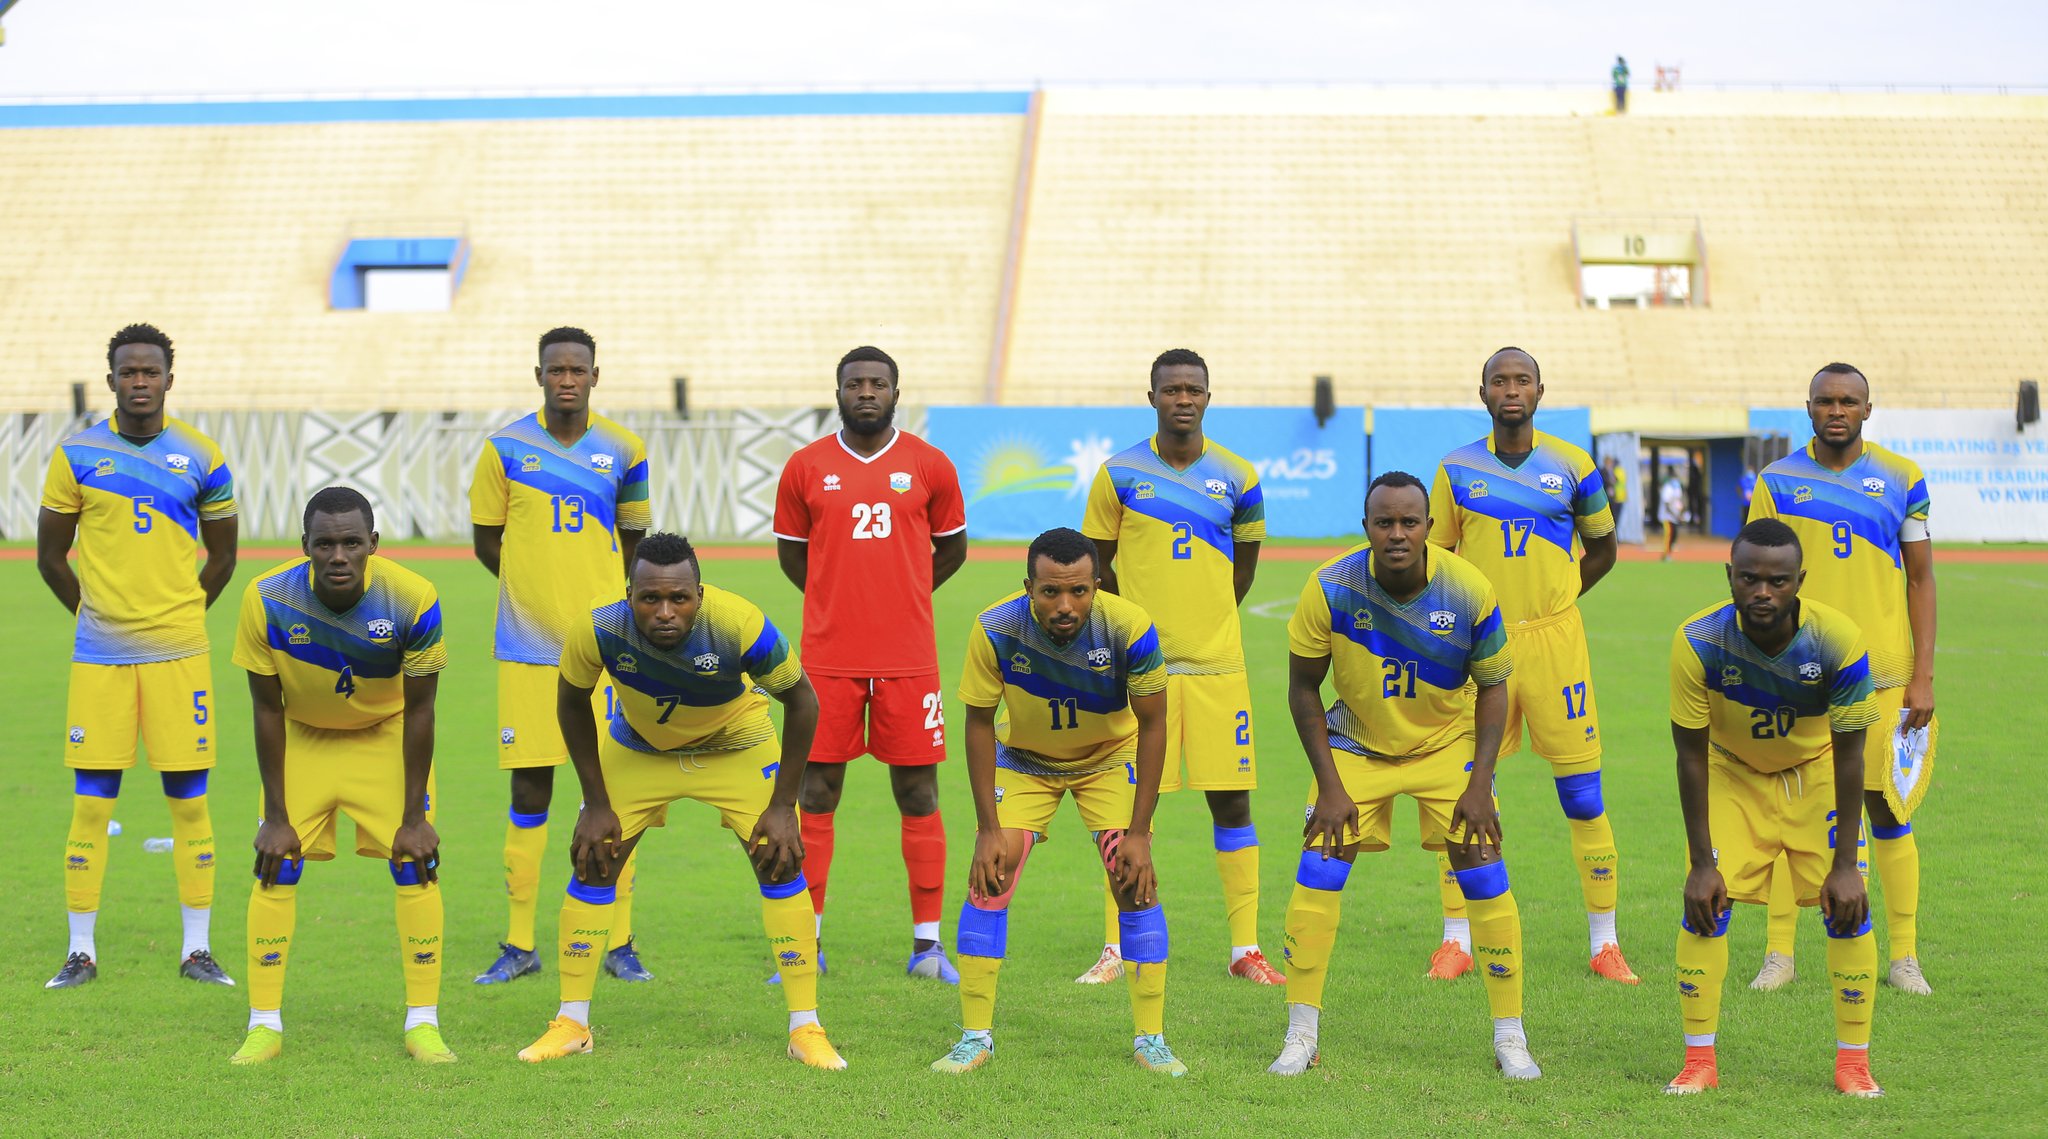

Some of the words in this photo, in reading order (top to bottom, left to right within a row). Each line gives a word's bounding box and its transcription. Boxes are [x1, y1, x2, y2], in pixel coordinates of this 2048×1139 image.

[1624, 235, 1646, 256] 10
[132, 496, 154, 534] 5
[550, 495, 585, 533] 13
[852, 502, 892, 540] 23
[1172, 521, 1192, 560] 2
[1500, 518, 1536, 558] 17
[1832, 521, 1852, 559] 9
[335, 665, 356, 699] 4
[1011, 664, 1031, 675] errea
[1382, 657, 1418, 699] 21
[193, 690, 208, 725] 5
[604, 685, 615, 720] 1
[655, 695, 681, 725] 7
[1048, 698, 1079, 731] 11
[1562, 680, 1587, 720] 17
[1235, 710, 1250, 746] 2
[1750, 706, 1797, 740] 20
[1584, 854, 1616, 862] RWA
[256, 935, 288, 945] RWA
[408, 935, 439, 945] RWA
[1478, 946, 1513, 956] RWA
[1834, 971, 1870, 981] RWA
